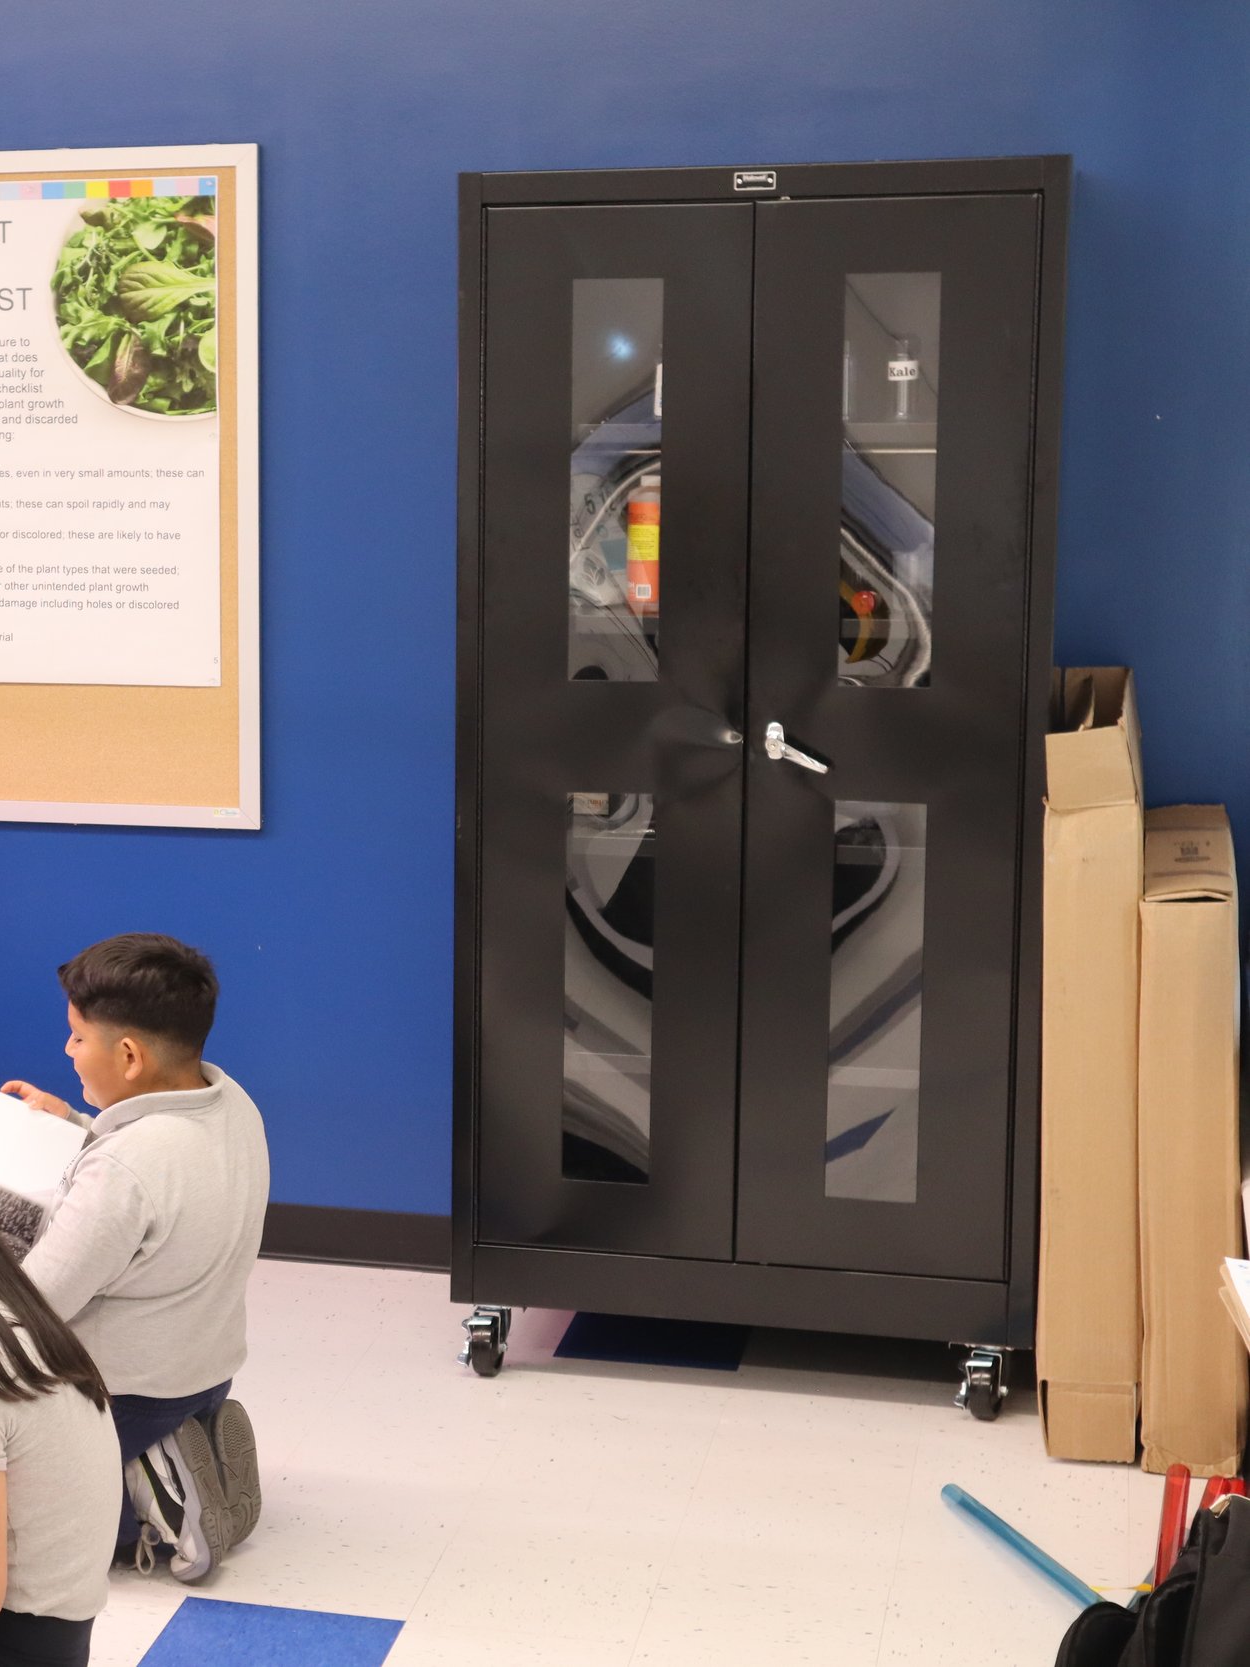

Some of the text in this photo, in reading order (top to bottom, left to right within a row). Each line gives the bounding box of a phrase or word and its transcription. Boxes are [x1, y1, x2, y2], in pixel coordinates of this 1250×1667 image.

[19, 337, 30, 346] to
[11, 351, 38, 362] does
[29, 367, 44, 377] for
[889, 366, 916, 377] Kale
[27, 398, 64, 411] growth
[1, 413, 22, 423] and
[24, 413, 78, 423] discarded
[42, 468, 51, 477] in
[54, 470, 75, 481] very
[78, 467, 104, 477] small
[156, 467, 184, 477] these
[15, 498, 43, 508] these
[66, 498, 89, 511] spoil
[92, 498, 125, 511] rapidly
[127, 498, 146, 508] and
[149, 501, 170, 511] may
[68, 529, 95, 539] these
[116, 529, 141, 543] likely
[144, 530, 154, 540] to
[156, 529, 181, 540] have
[5, 563, 15, 573] of
[17, 563, 33, 573] the
[36, 563, 60, 577] plant
[62, 564, 89, 577] types
[91, 564, 110, 574] that
[4, 580, 28, 590] other
[31, 580, 86, 591] unintended
[88, 581, 113, 594] plant
[115, 581, 149, 594] growth
[40, 597, 83, 611] including
[86, 598, 112, 608] holes
[128, 598, 179, 609] discolored
